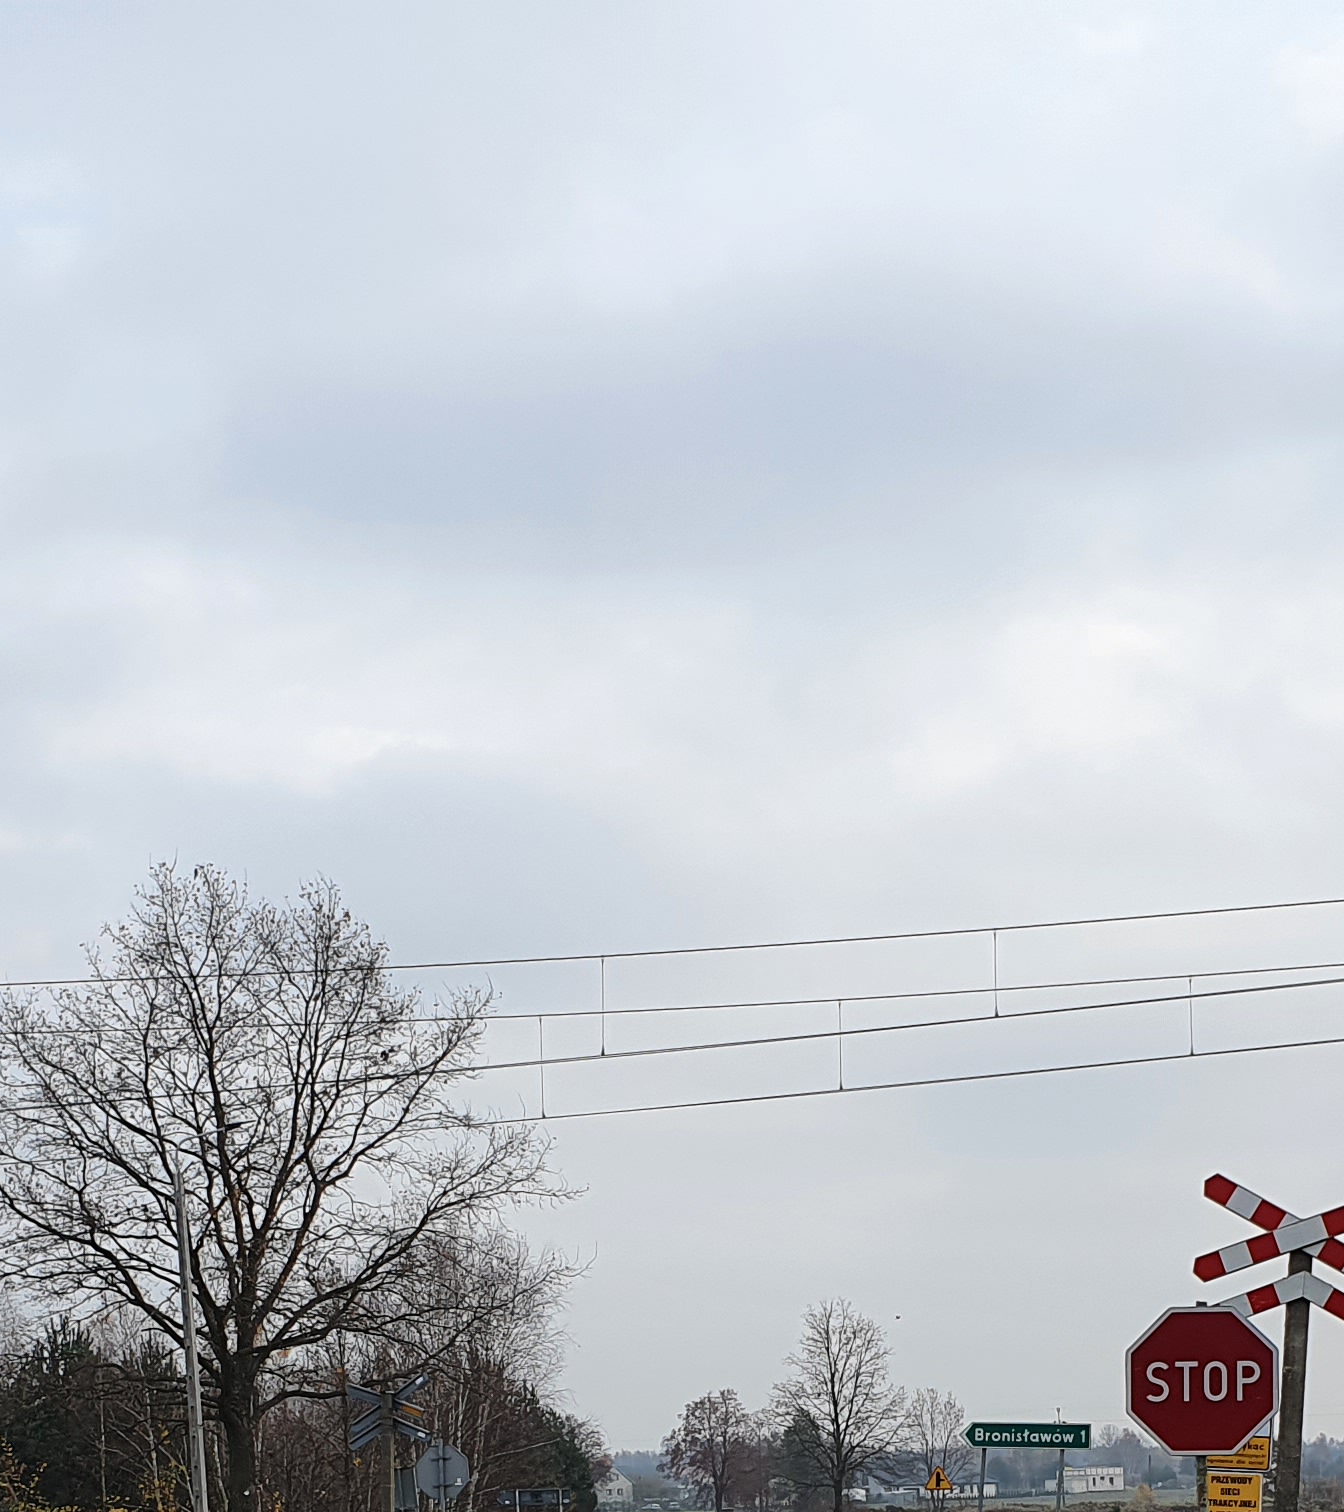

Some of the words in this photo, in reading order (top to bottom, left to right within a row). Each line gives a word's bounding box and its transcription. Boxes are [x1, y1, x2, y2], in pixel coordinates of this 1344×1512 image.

[1146, 1360, 1261, 1403] STOP
[974, 1428, 1075, 1443] Bronisławów
[1080, 1429, 1086, 1443] 1
[1211, 1475, 1253, 1485] PRZEWODY
[1220, 1487, 1240, 1496] SIECI
